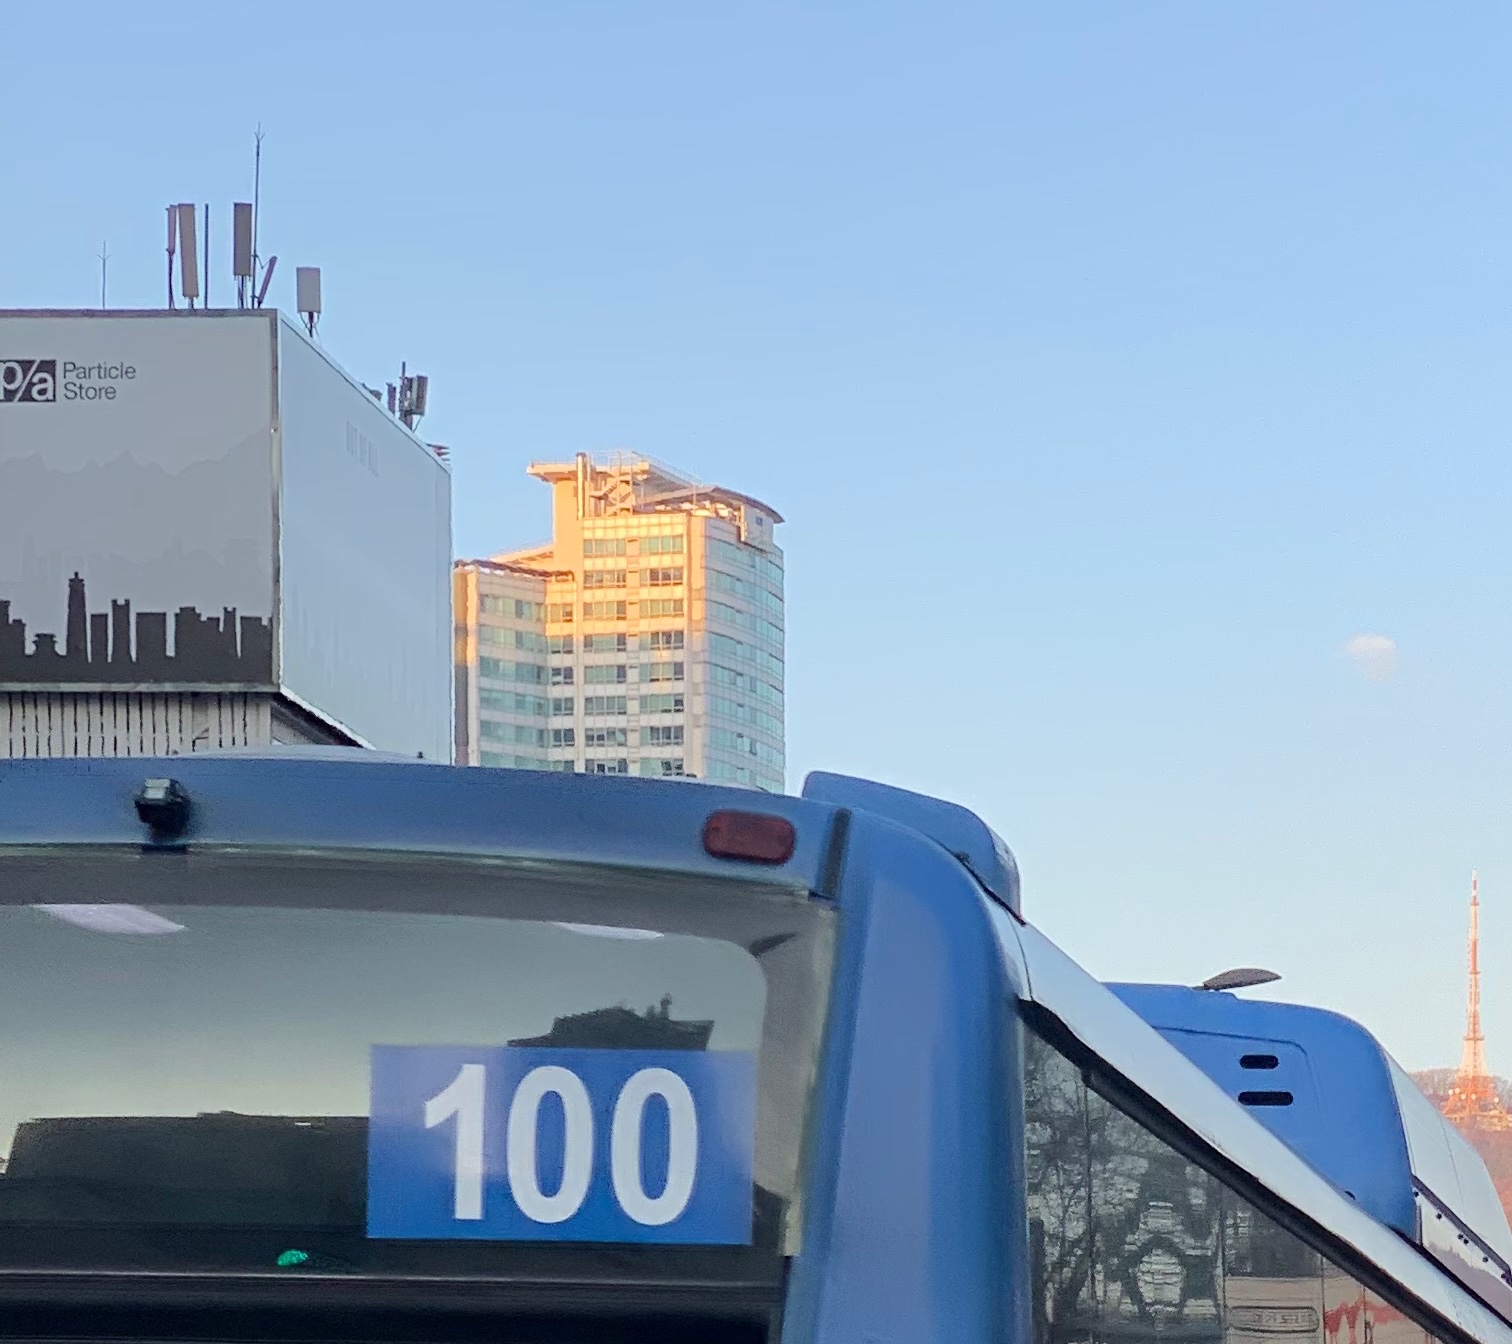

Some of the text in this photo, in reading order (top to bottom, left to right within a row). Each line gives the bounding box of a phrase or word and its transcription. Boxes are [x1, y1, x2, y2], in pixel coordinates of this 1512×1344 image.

[62, 361, 137, 380] Particle
[63, 381, 117, 401] Store
[423, 1062, 698, 1226] 100
